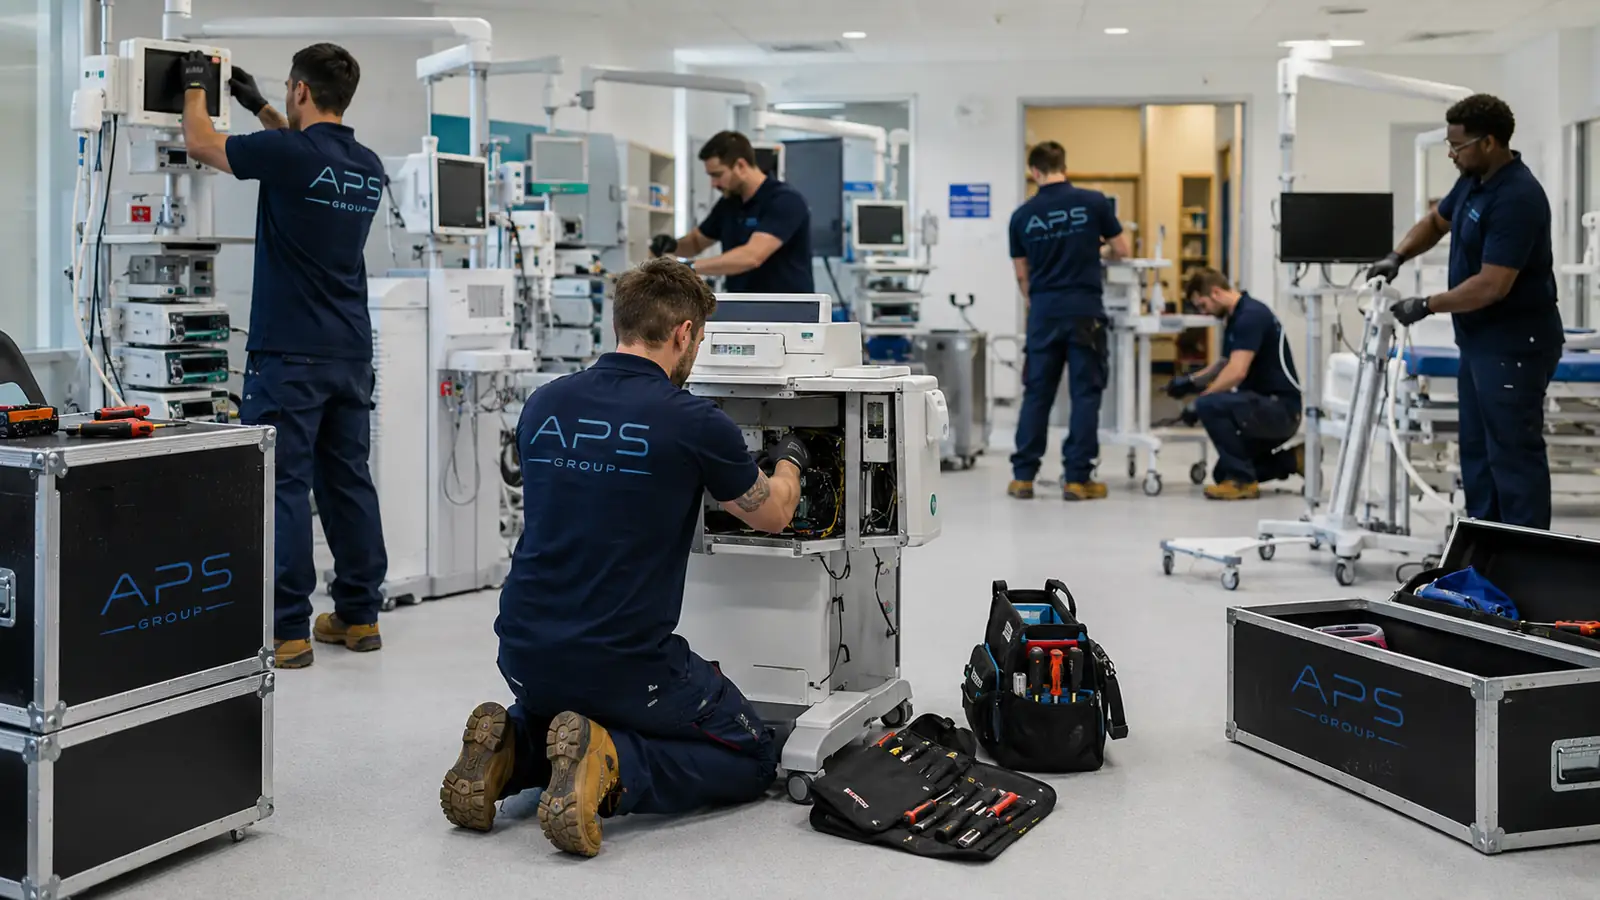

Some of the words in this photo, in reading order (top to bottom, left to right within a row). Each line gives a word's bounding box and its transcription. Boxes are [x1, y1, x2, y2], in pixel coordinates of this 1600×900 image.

[309, 166, 381, 201] APS
[332, 200, 367, 213] GROUP
[1025, 206, 1088, 234] APS
[529, 415, 650, 457] APS
[553, 457, 616, 473] GROUP
[100, 552, 232, 615] APS
[138, 605, 202, 630] GROUP
[1291, 664, 1404, 728] APS
[1319, 714, 1376, 739] GROUP
